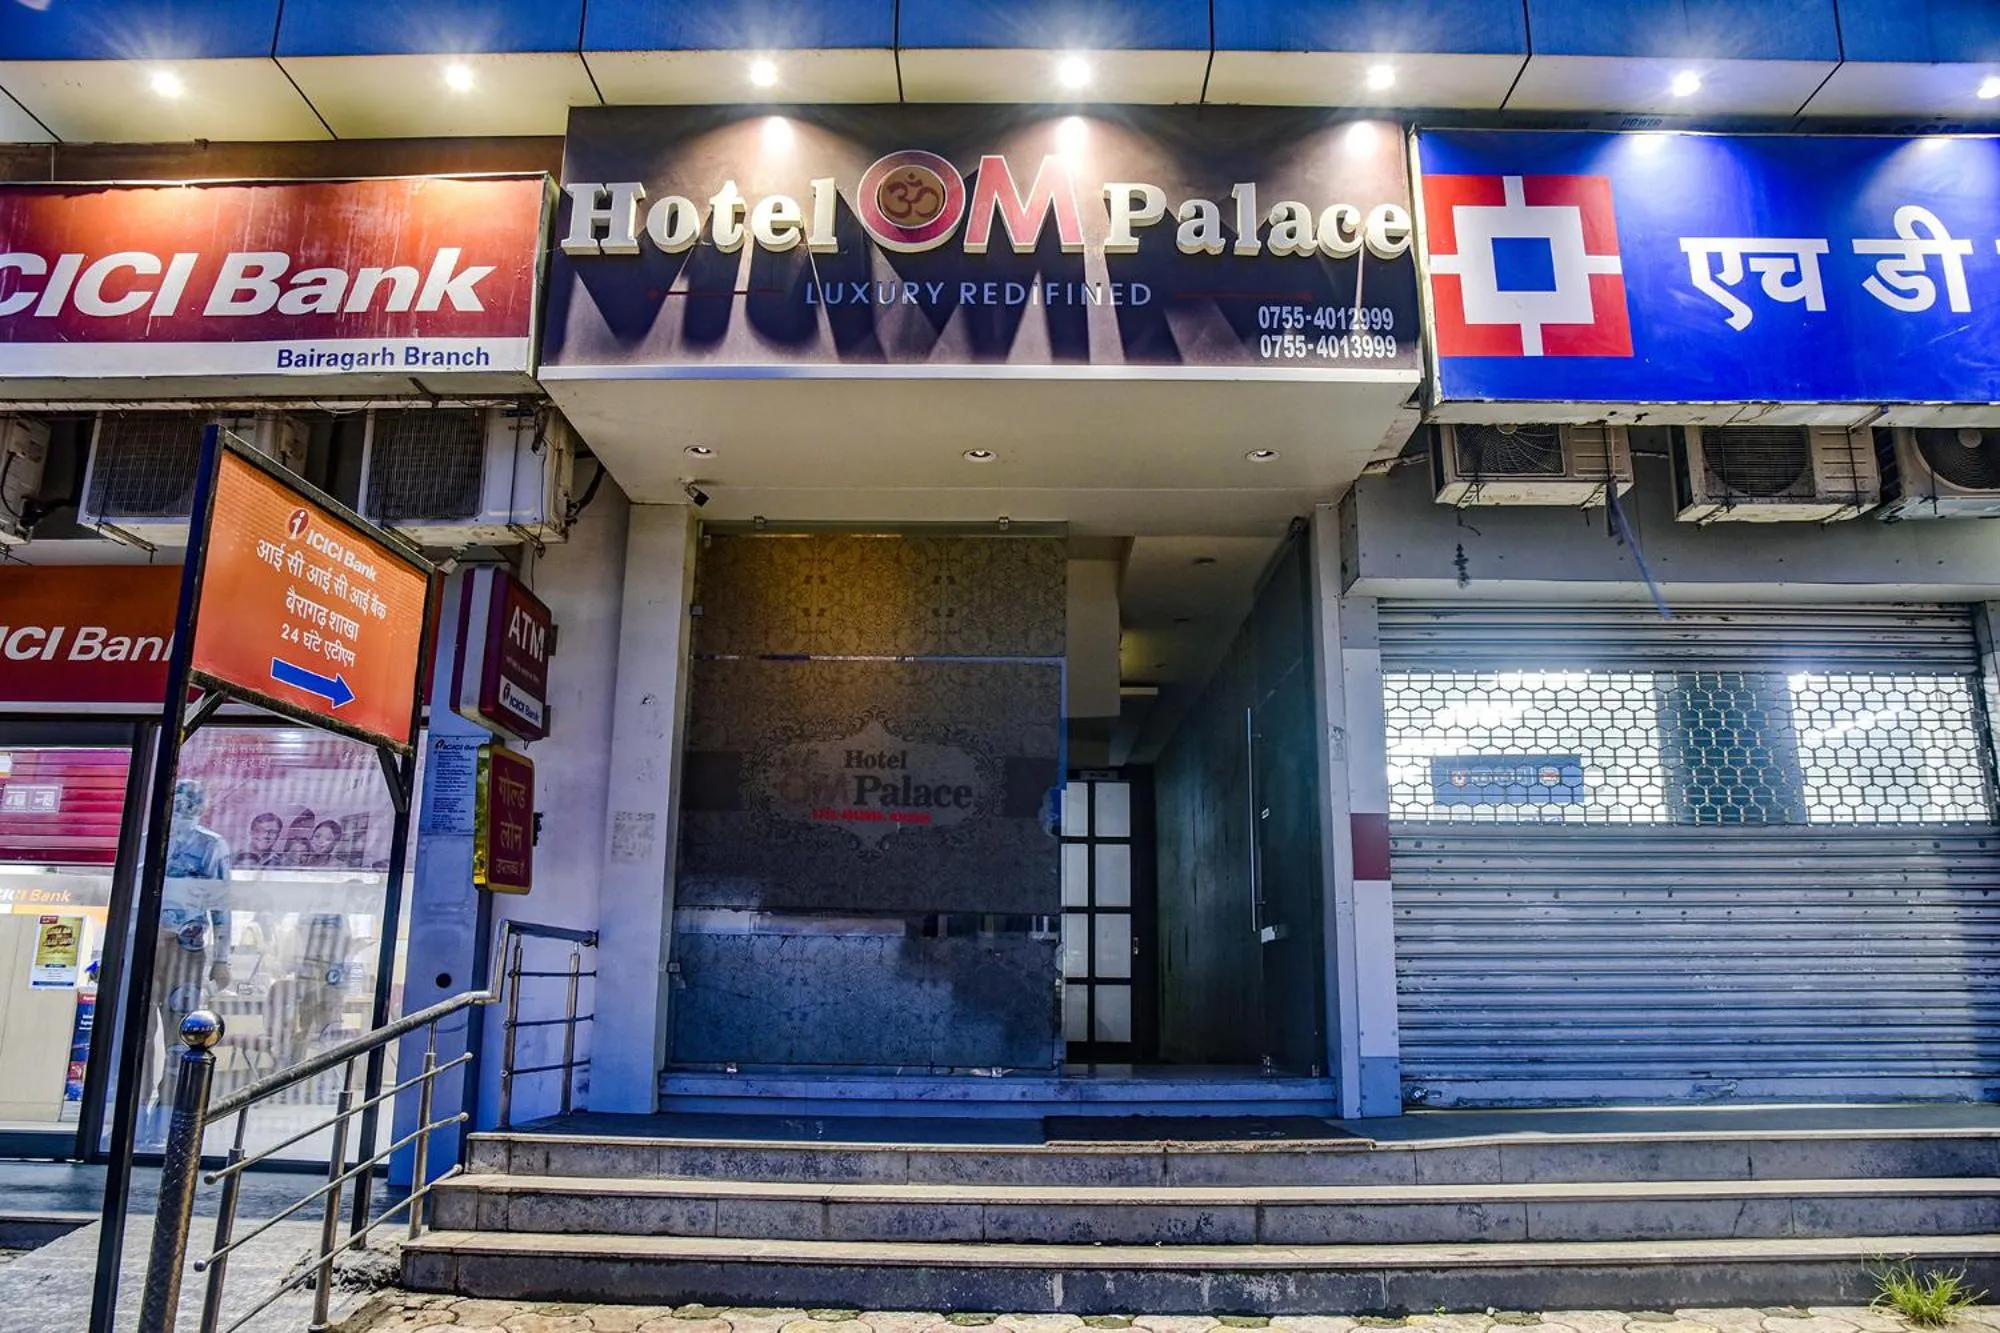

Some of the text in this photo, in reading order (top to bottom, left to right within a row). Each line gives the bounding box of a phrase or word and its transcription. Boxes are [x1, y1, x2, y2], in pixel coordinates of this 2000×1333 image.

[560, 149, 1412, 260] Hotel OM Palace
[203, 247, 497, 316] Bank
[1679, 205, 1973, 331] एच डी
[805, 282, 1151, 306] LUXURY REDIFINED
[1258, 305, 1394, 331] 0755-4012999
[276, 346, 490, 370] Bairagarh Branch
[1260, 334, 1397, 358] 0755-4013999
[306, 529, 377, 582] ICICI Bank
[256, 538, 286, 572] आई
[287, 550, 305, 578] सी
[306, 563, 332, 594] आई
[333, 573, 348, 599] सी
[350, 586, 370, 616] आई
[0, 626, 65, 661] CI
[329, 611, 360, 642] शाखा
[508, 605, 545, 662] ATM
[281, 623, 300, 643] 24
[324, 640, 356, 667] एटीएम
[845, 749, 908, 769] Hotel
[853, 775, 973, 808] Palace
[31, 888, 71, 902] Bank
